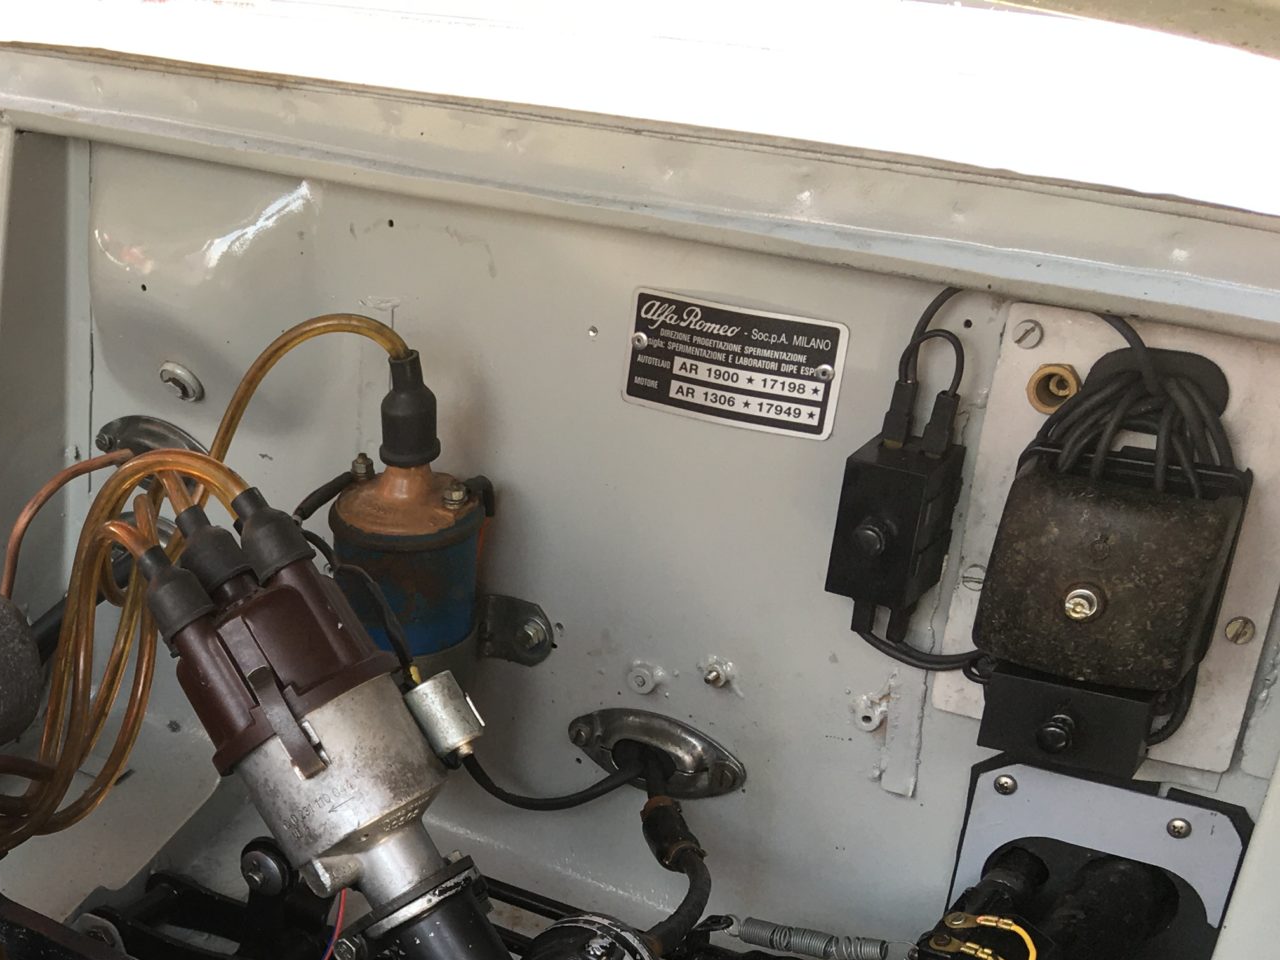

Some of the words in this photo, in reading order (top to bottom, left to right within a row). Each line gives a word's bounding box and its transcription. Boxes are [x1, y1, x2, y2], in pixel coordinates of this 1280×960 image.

[640, 299, 680, 330] Alfa
[679, 307, 740, 337] Romeo
[751, 329, 789, 345] Soc.p.A.
[792, 335, 831, 351] MILANO
[660, 329, 691, 342] DIREZIONE
[692, 335, 742, 353] PROGETTAZIONE
[744, 345, 807, 363] SPERIMENTAZIONE
[667, 341, 726, 362] SPERIMENTAZIONE
[728, 355, 733, 363] E
[735, 356, 778, 371] LABORATORI
[637, 354, 671, 369] AUTOTELAIO
[679, 361, 699, 375] AR
[706, 367, 740, 383] 1900
[761, 378, 806, 395] 17198
[634, 376, 658, 389] MOTORE
[675, 385, 695, 399] AR
[702, 391, 735, 408] 1306
[757, 402, 801, 419] 17949
